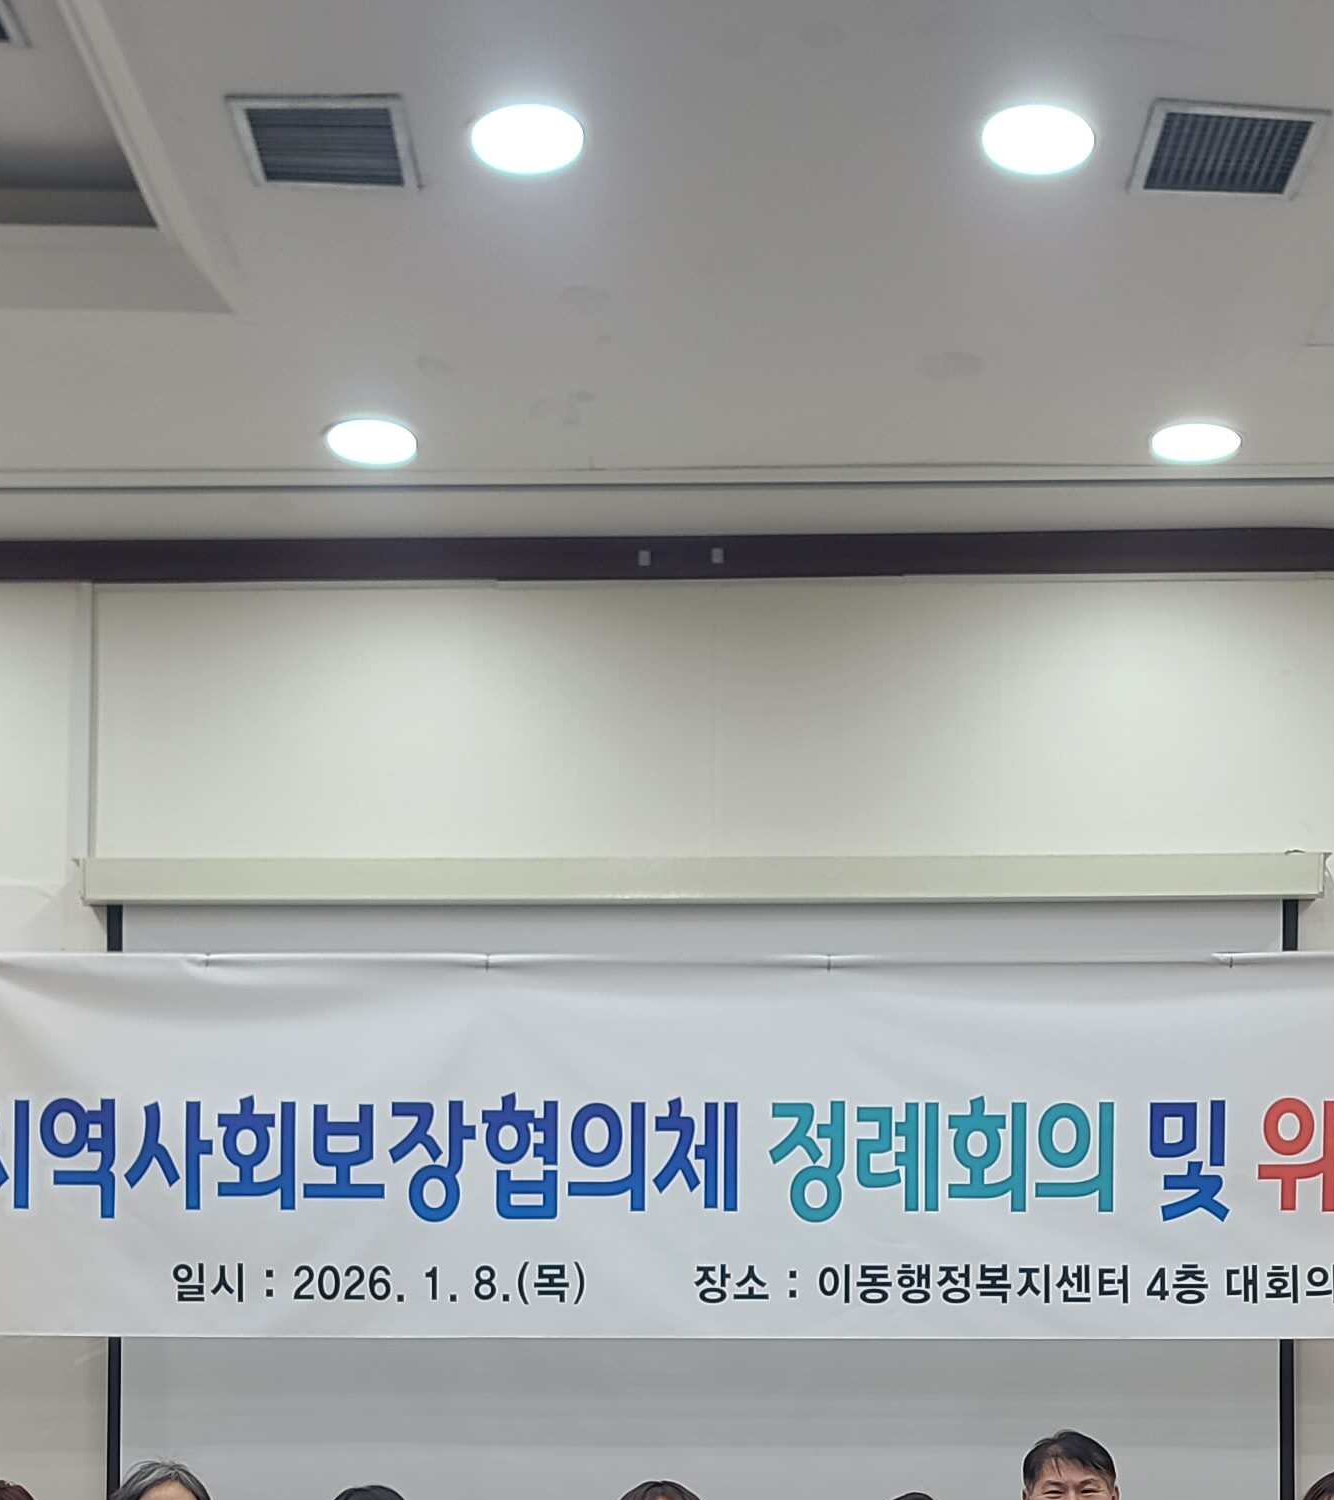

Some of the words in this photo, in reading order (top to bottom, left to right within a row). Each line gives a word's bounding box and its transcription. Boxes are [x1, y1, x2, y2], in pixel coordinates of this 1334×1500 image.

[769, 1096, 1116, 1224] 정례회의
[1149, 1100, 1230, 1223] 및
[173, 1264, 245, 1304] 일시
[294, 1266, 405, 1303] 2026.
[475, 1263, 587, 1306] 8.(목)
[695, 1264, 770, 1305] 장소
[819, 1265, 1130, 1305] 이동행정복지센터
[1147, 1265, 1210, 1306] 4층
